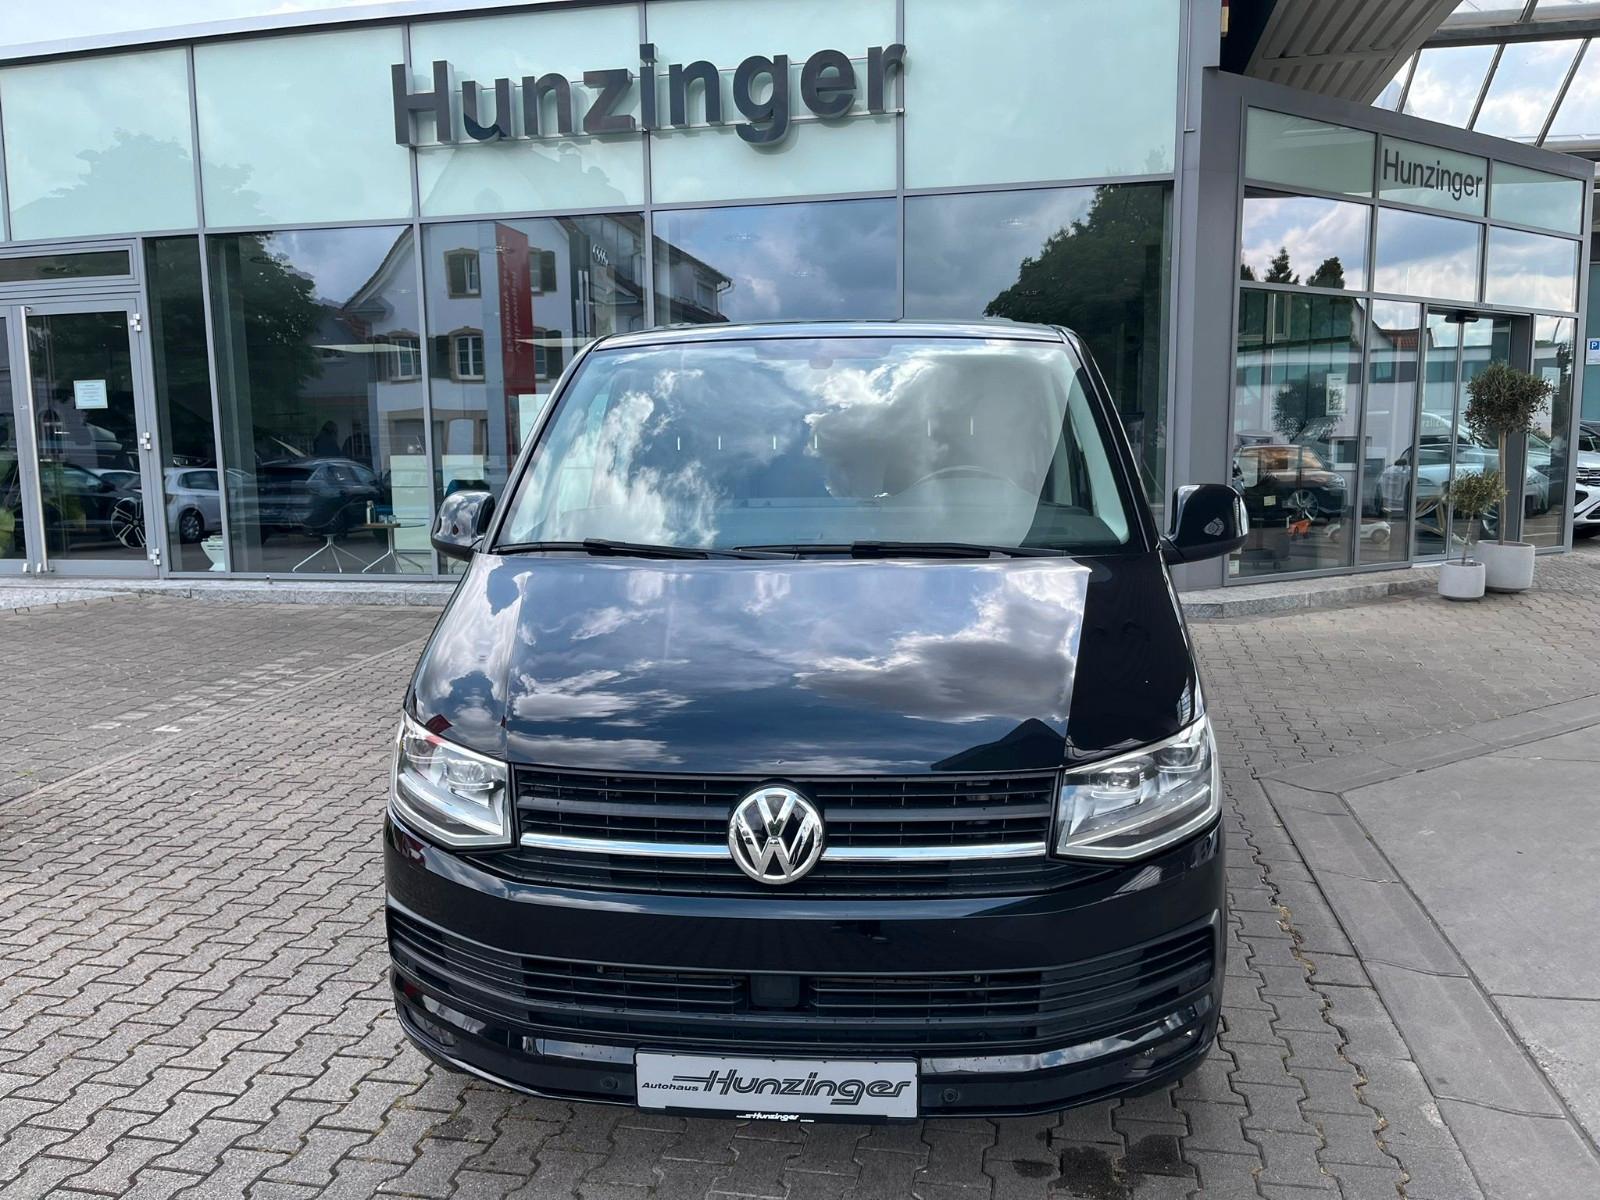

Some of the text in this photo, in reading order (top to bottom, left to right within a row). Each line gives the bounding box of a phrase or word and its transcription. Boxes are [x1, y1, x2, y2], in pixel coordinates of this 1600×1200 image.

[391, 43, 907, 147] Hunzinger
[1383, 148, 1483, 201] Hunzinger
[729, 787, 823, 885] VW
[641, 1068, 911, 1106] Autohaus Hunzinger
[746, 1112, 800, 1122] Hunzinger
